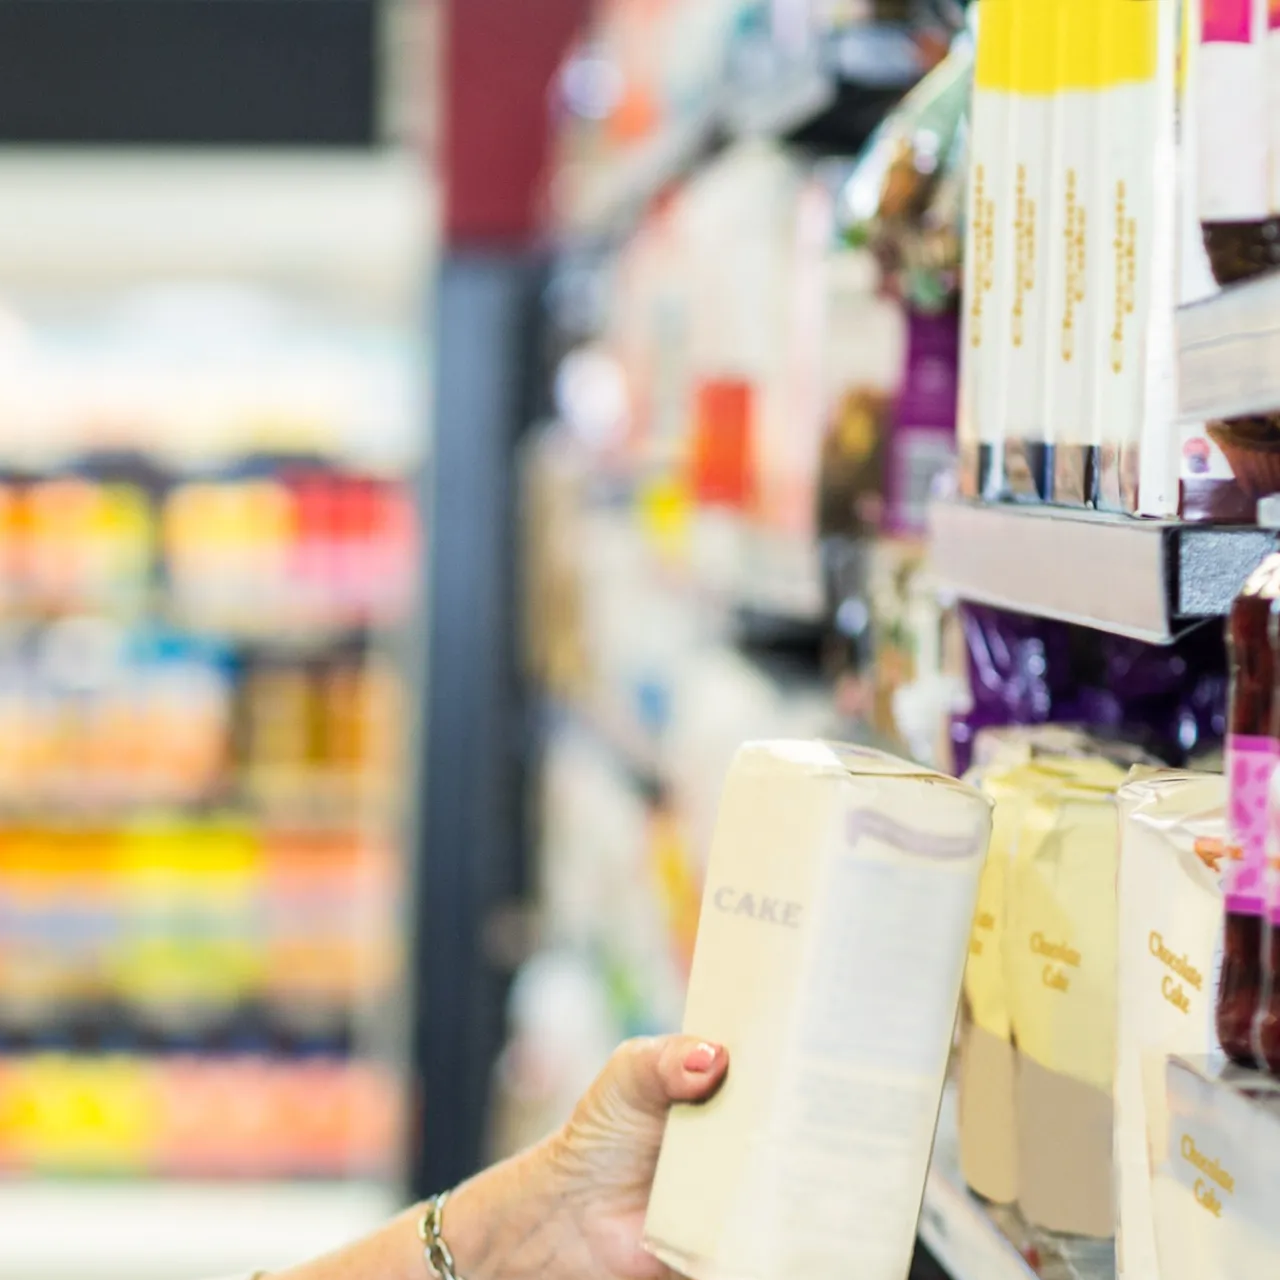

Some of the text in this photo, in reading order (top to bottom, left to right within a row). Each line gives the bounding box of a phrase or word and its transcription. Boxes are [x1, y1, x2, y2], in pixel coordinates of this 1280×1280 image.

[714, 885, 804, 929] CAKE
[1041, 963, 1069, 993] Cake
[1149, 930, 1203, 992] Chocolate
[1161, 975, 1190, 1014] Cake
[1181, 1134, 1235, 1194] Chocolate
[1193, 1178, 1222, 1218] Cake
